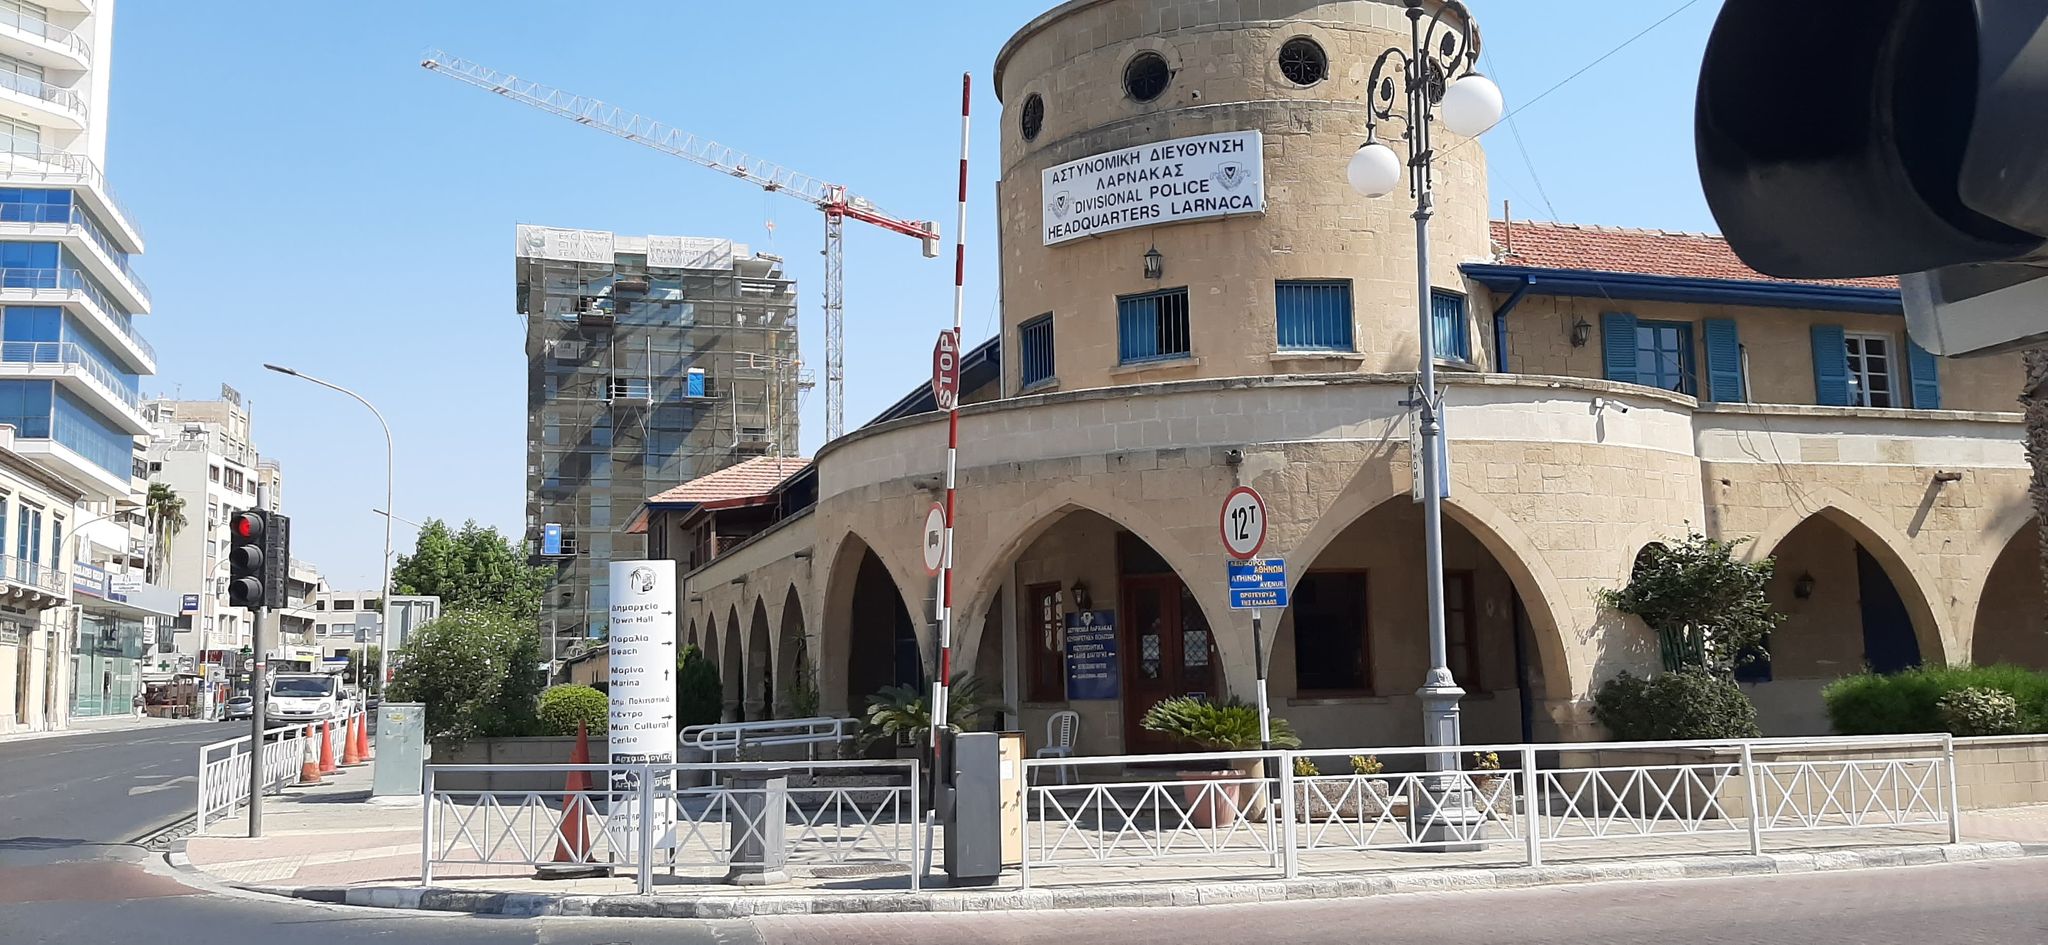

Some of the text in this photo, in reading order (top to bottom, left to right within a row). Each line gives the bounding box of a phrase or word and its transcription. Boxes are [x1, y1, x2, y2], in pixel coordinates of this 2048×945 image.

[1052, 139, 1244, 184] ΑΣΤΥΝΟΜΙΚΗ ΔΙΕΥΘΥΝΣΗ
[1096, 163, 1184, 190] ΛΑΡΝΑΚΑΣ
[1075, 179, 1209, 214] DIVISIONAL POLICE
[1048, 195, 1253, 239] HEADQUARTERS LARNACA
[581, 251, 604, 259] VIEW
[939, 334, 953, 407] STOP
[1254, 565, 1283, 573] ΑΘΗΝΩΝ
[611, 615, 654, 625] Town Hall
[611, 647, 638, 656] Beach
[611, 679, 640, 687] Marina
[634, 720, 669, 730] Cultural
[611, 736, 638, 744] Centre
